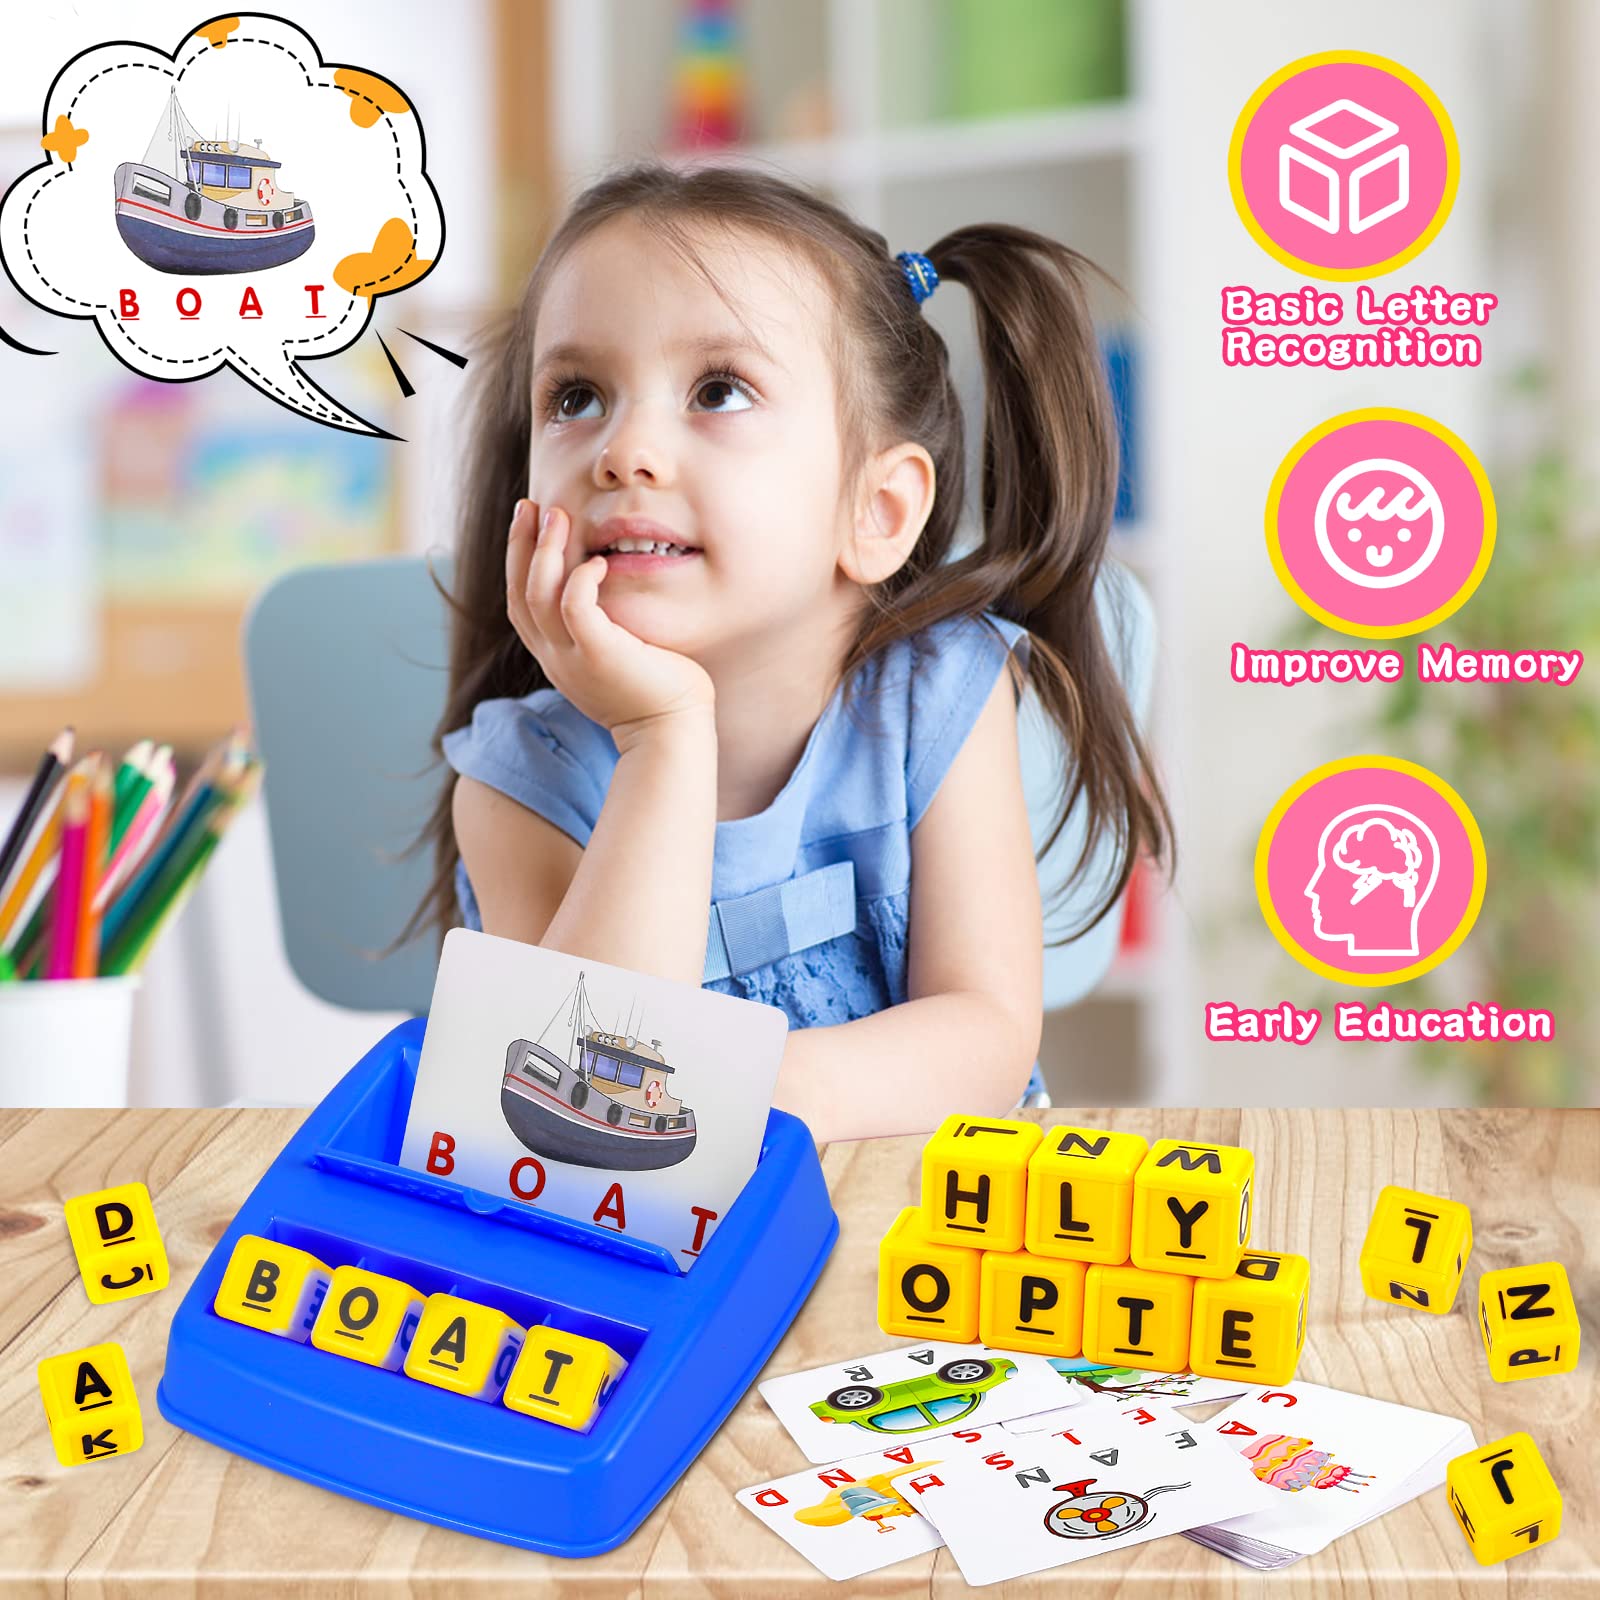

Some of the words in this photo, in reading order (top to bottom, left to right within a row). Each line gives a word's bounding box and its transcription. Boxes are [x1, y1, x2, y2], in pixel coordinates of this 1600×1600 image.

[94, 1202, 134, 1242] D
[945, 1169, 991, 1226] H
[1058, 1181, 1090, 1235] L
[1166, 1196, 1209, 1250] Y
[1405, 1216, 1433, 1264] L
[901, 1263, 951, 1314] O
[1019, 1275, 1059, 1325] P
[1116, 1296, 1155, 1348] T
[1221, 1309, 1254, 1359] E
[74, 1361, 113, 1405] A
[81, 1428, 118, 1456] K
[1488, 1456, 1515, 1505] J
